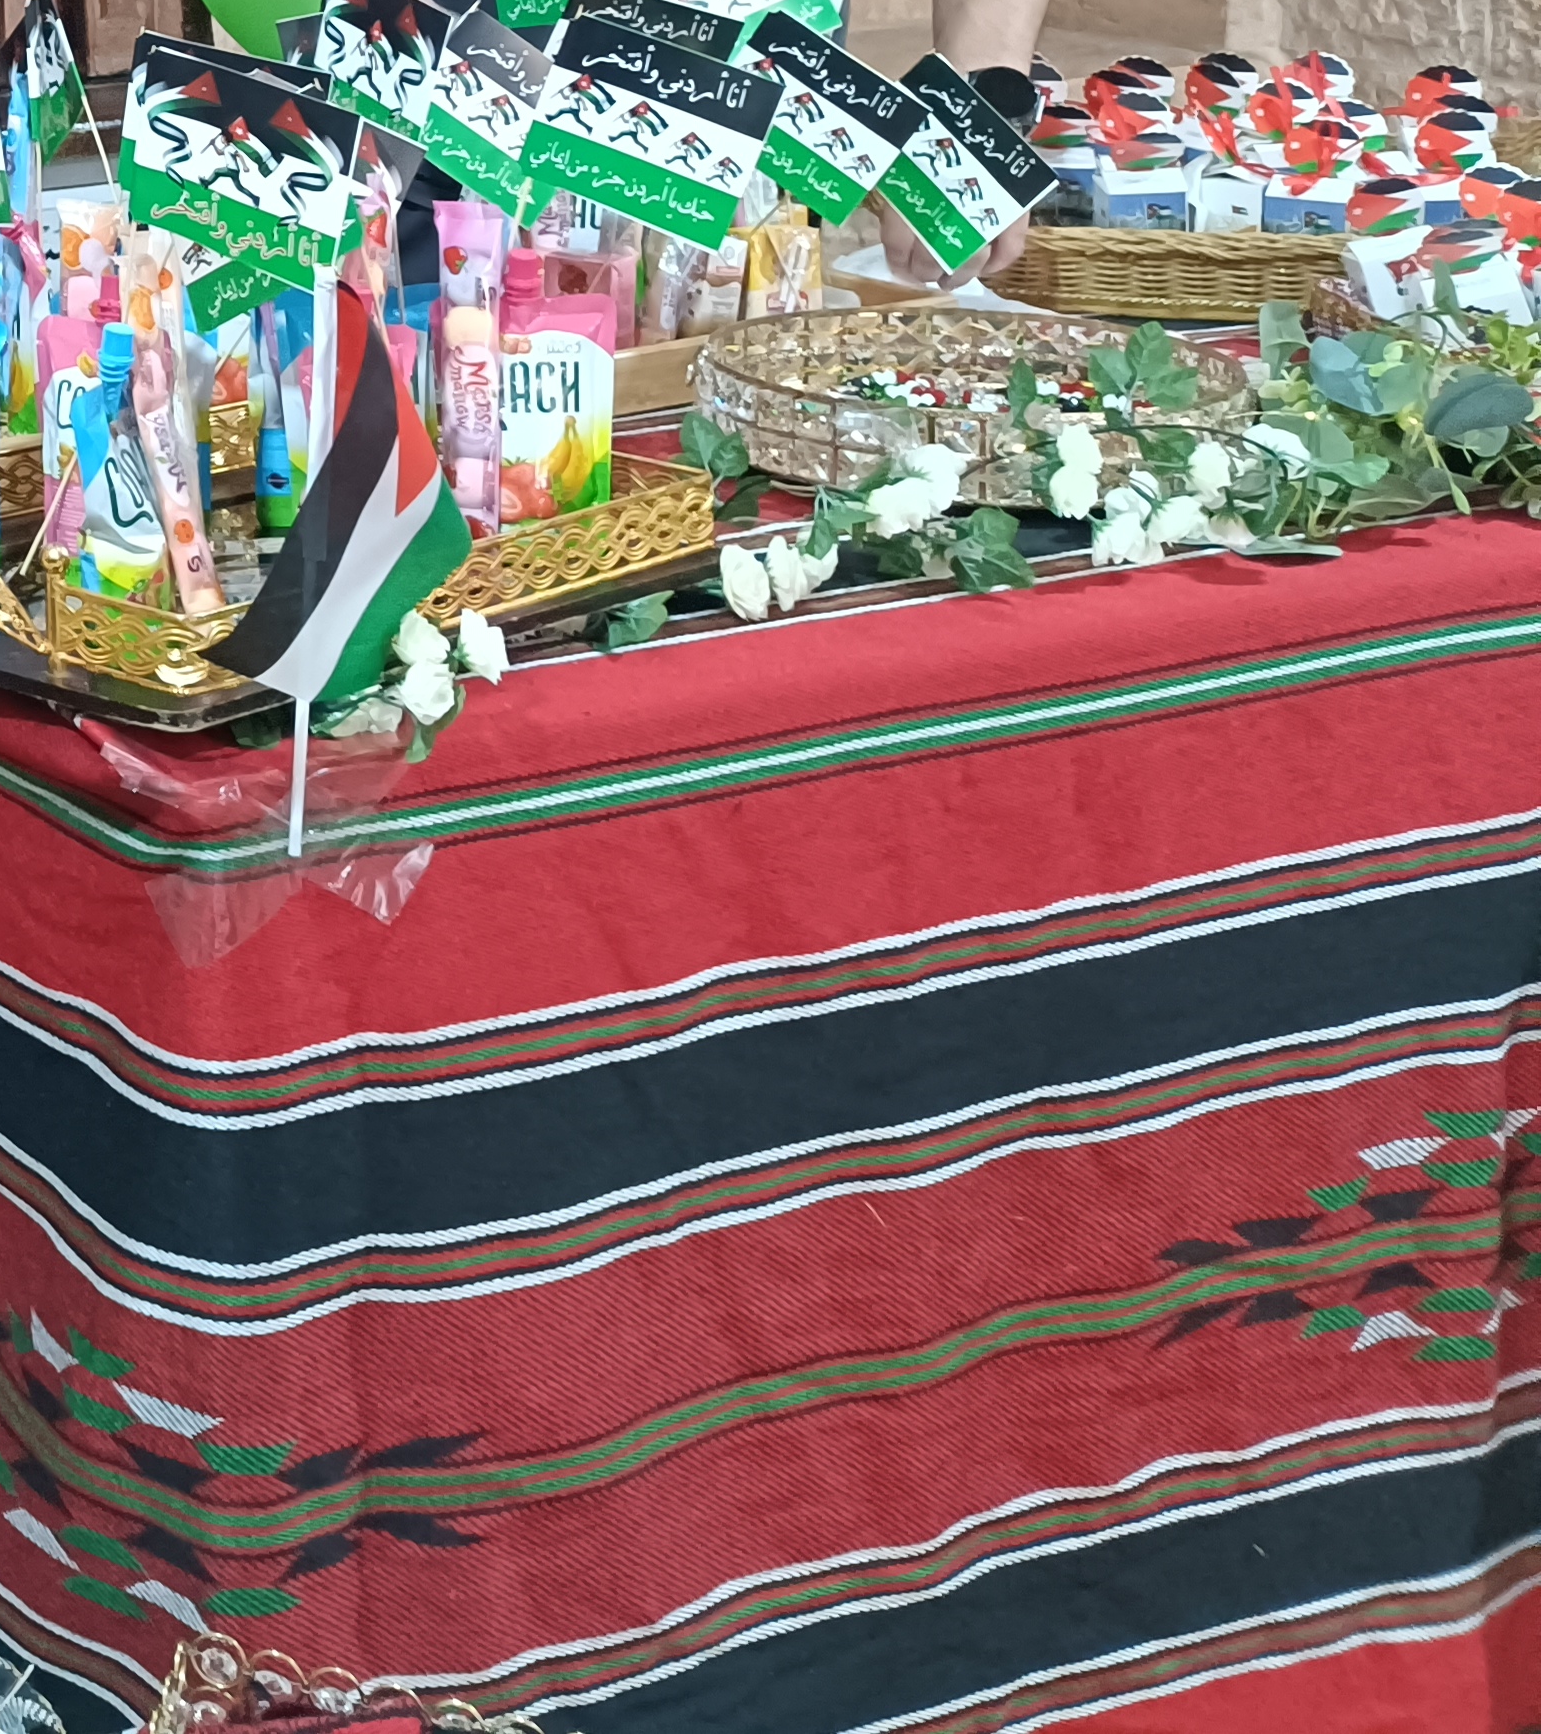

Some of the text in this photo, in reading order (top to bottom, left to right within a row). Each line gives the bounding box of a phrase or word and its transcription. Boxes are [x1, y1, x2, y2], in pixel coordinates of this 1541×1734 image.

[581, 44, 752, 109] أنا أردني وأفتخر
[565, 160, 589, 177] من
[509, 360, 580, 414] ACH
